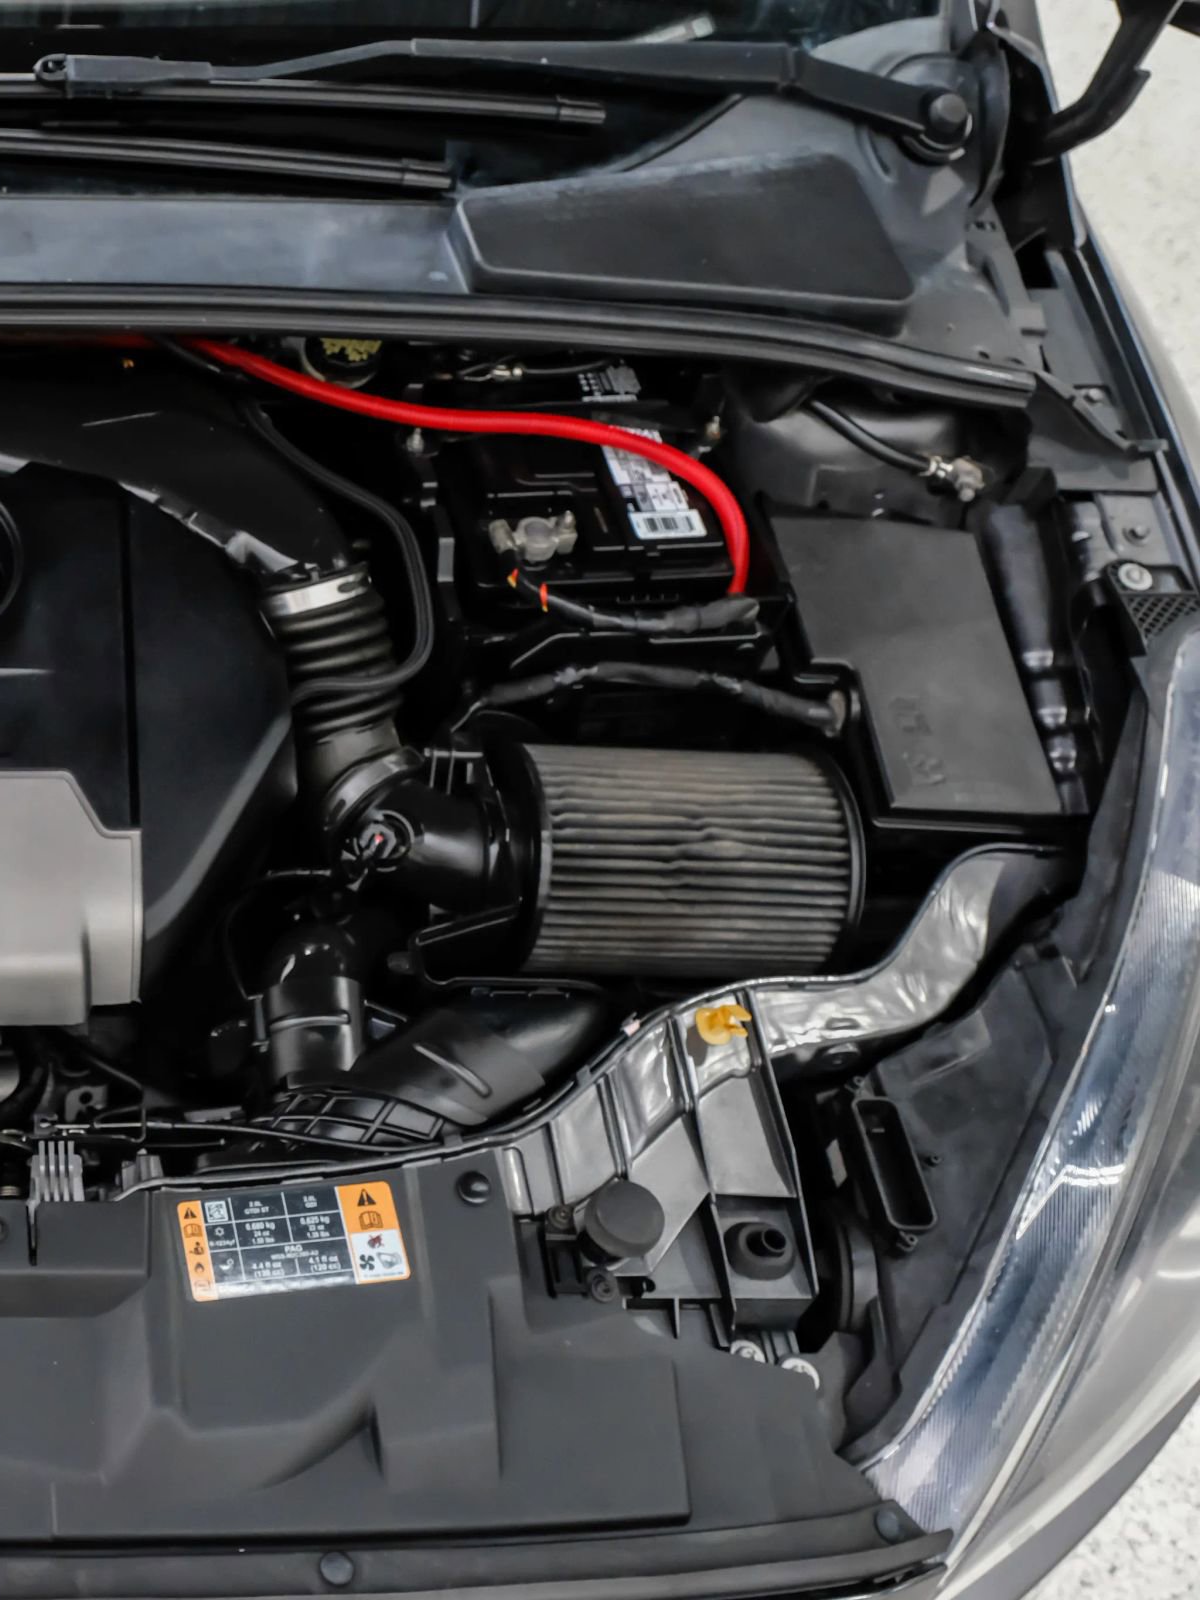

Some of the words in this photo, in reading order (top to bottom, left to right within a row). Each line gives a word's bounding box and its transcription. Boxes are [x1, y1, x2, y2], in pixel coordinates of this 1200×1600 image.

[320, 1215, 331, 1225] kg
[265, 1221, 276, 1231] kg
[284, 1244, 303, 1253] PAG
